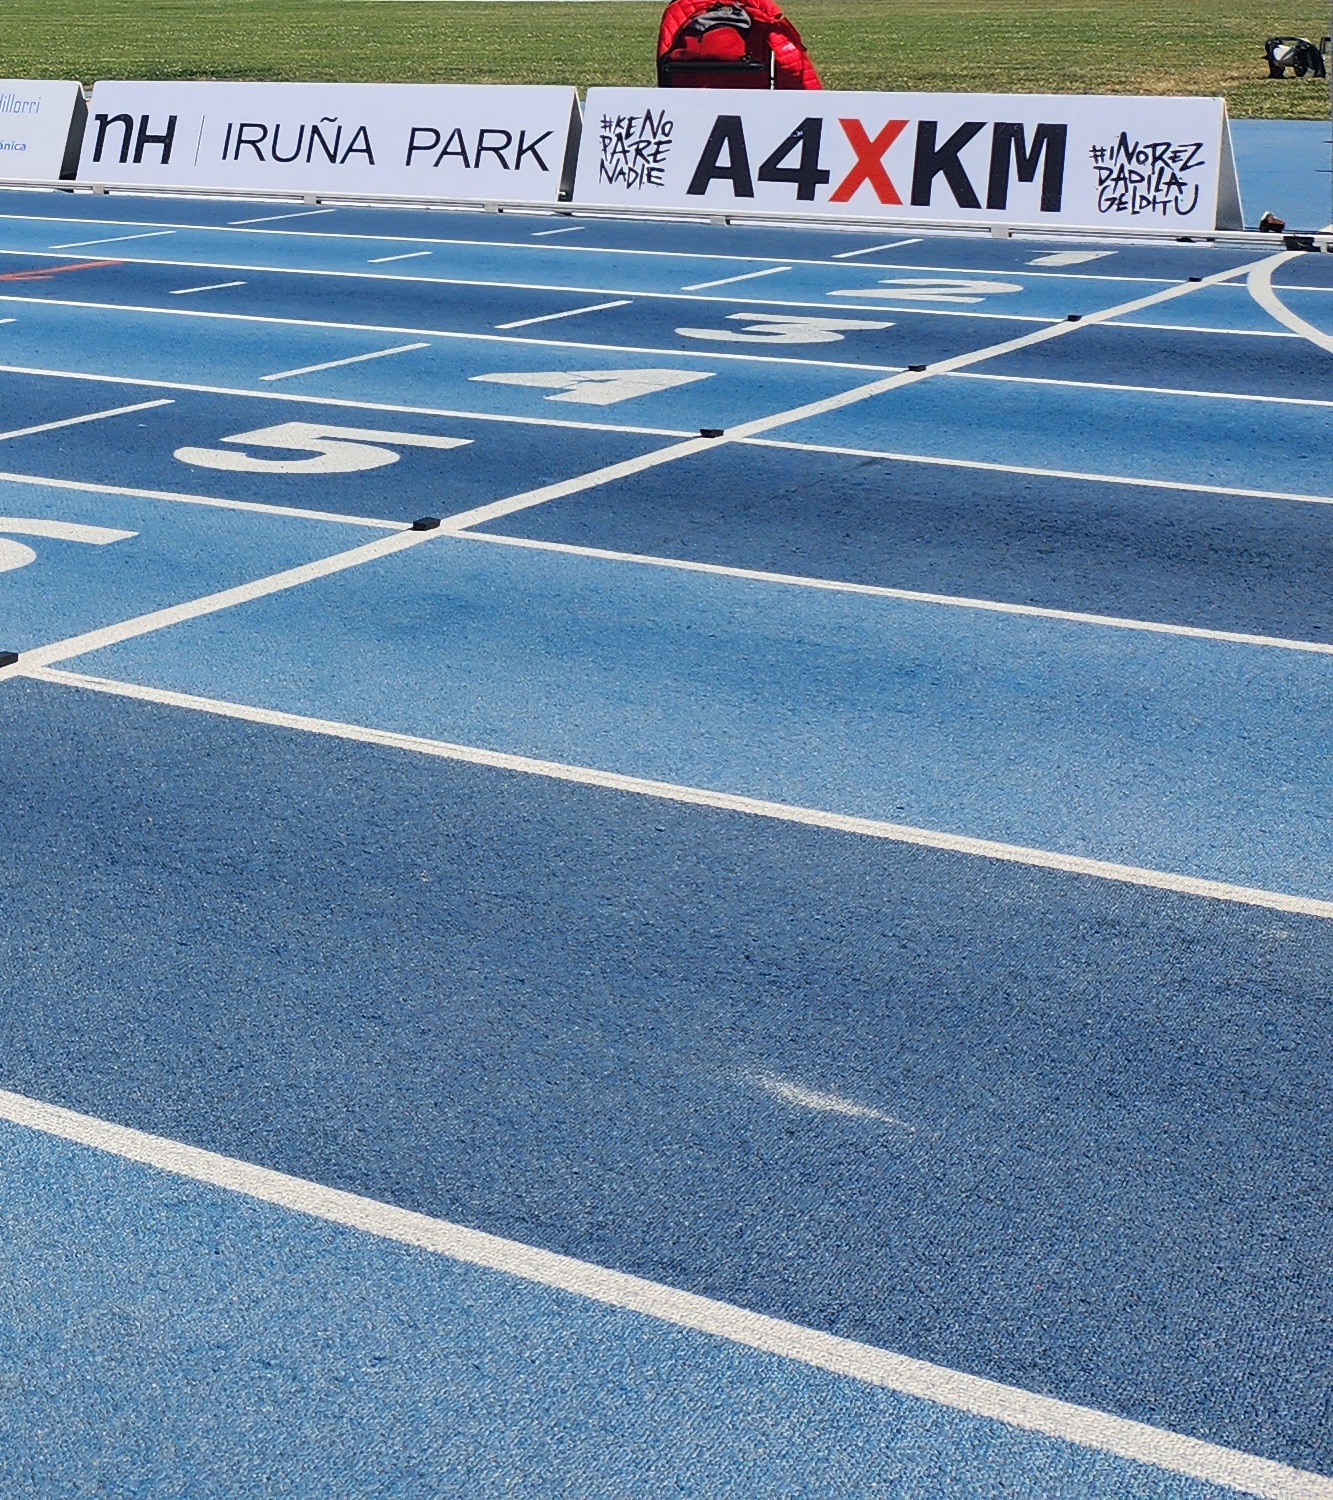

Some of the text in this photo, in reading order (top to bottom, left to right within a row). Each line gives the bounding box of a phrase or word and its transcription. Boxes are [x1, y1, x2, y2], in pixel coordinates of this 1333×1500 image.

[221, 116, 555, 172] IRUÑA PARK
[599, 132, 673, 165] PARE
[1089, 131, 1205, 174] #INOREZ
[598, 158, 665, 190] NADIE
[686, 115, 1068, 212] A4XKM
[1098, 184, 1199, 216] GELDITU
[827, 278, 1024, 303] 2
[674, 312, 896, 344] 3
[468, 368, 716, 405] 4
[173, 422, 475, 474] 5
